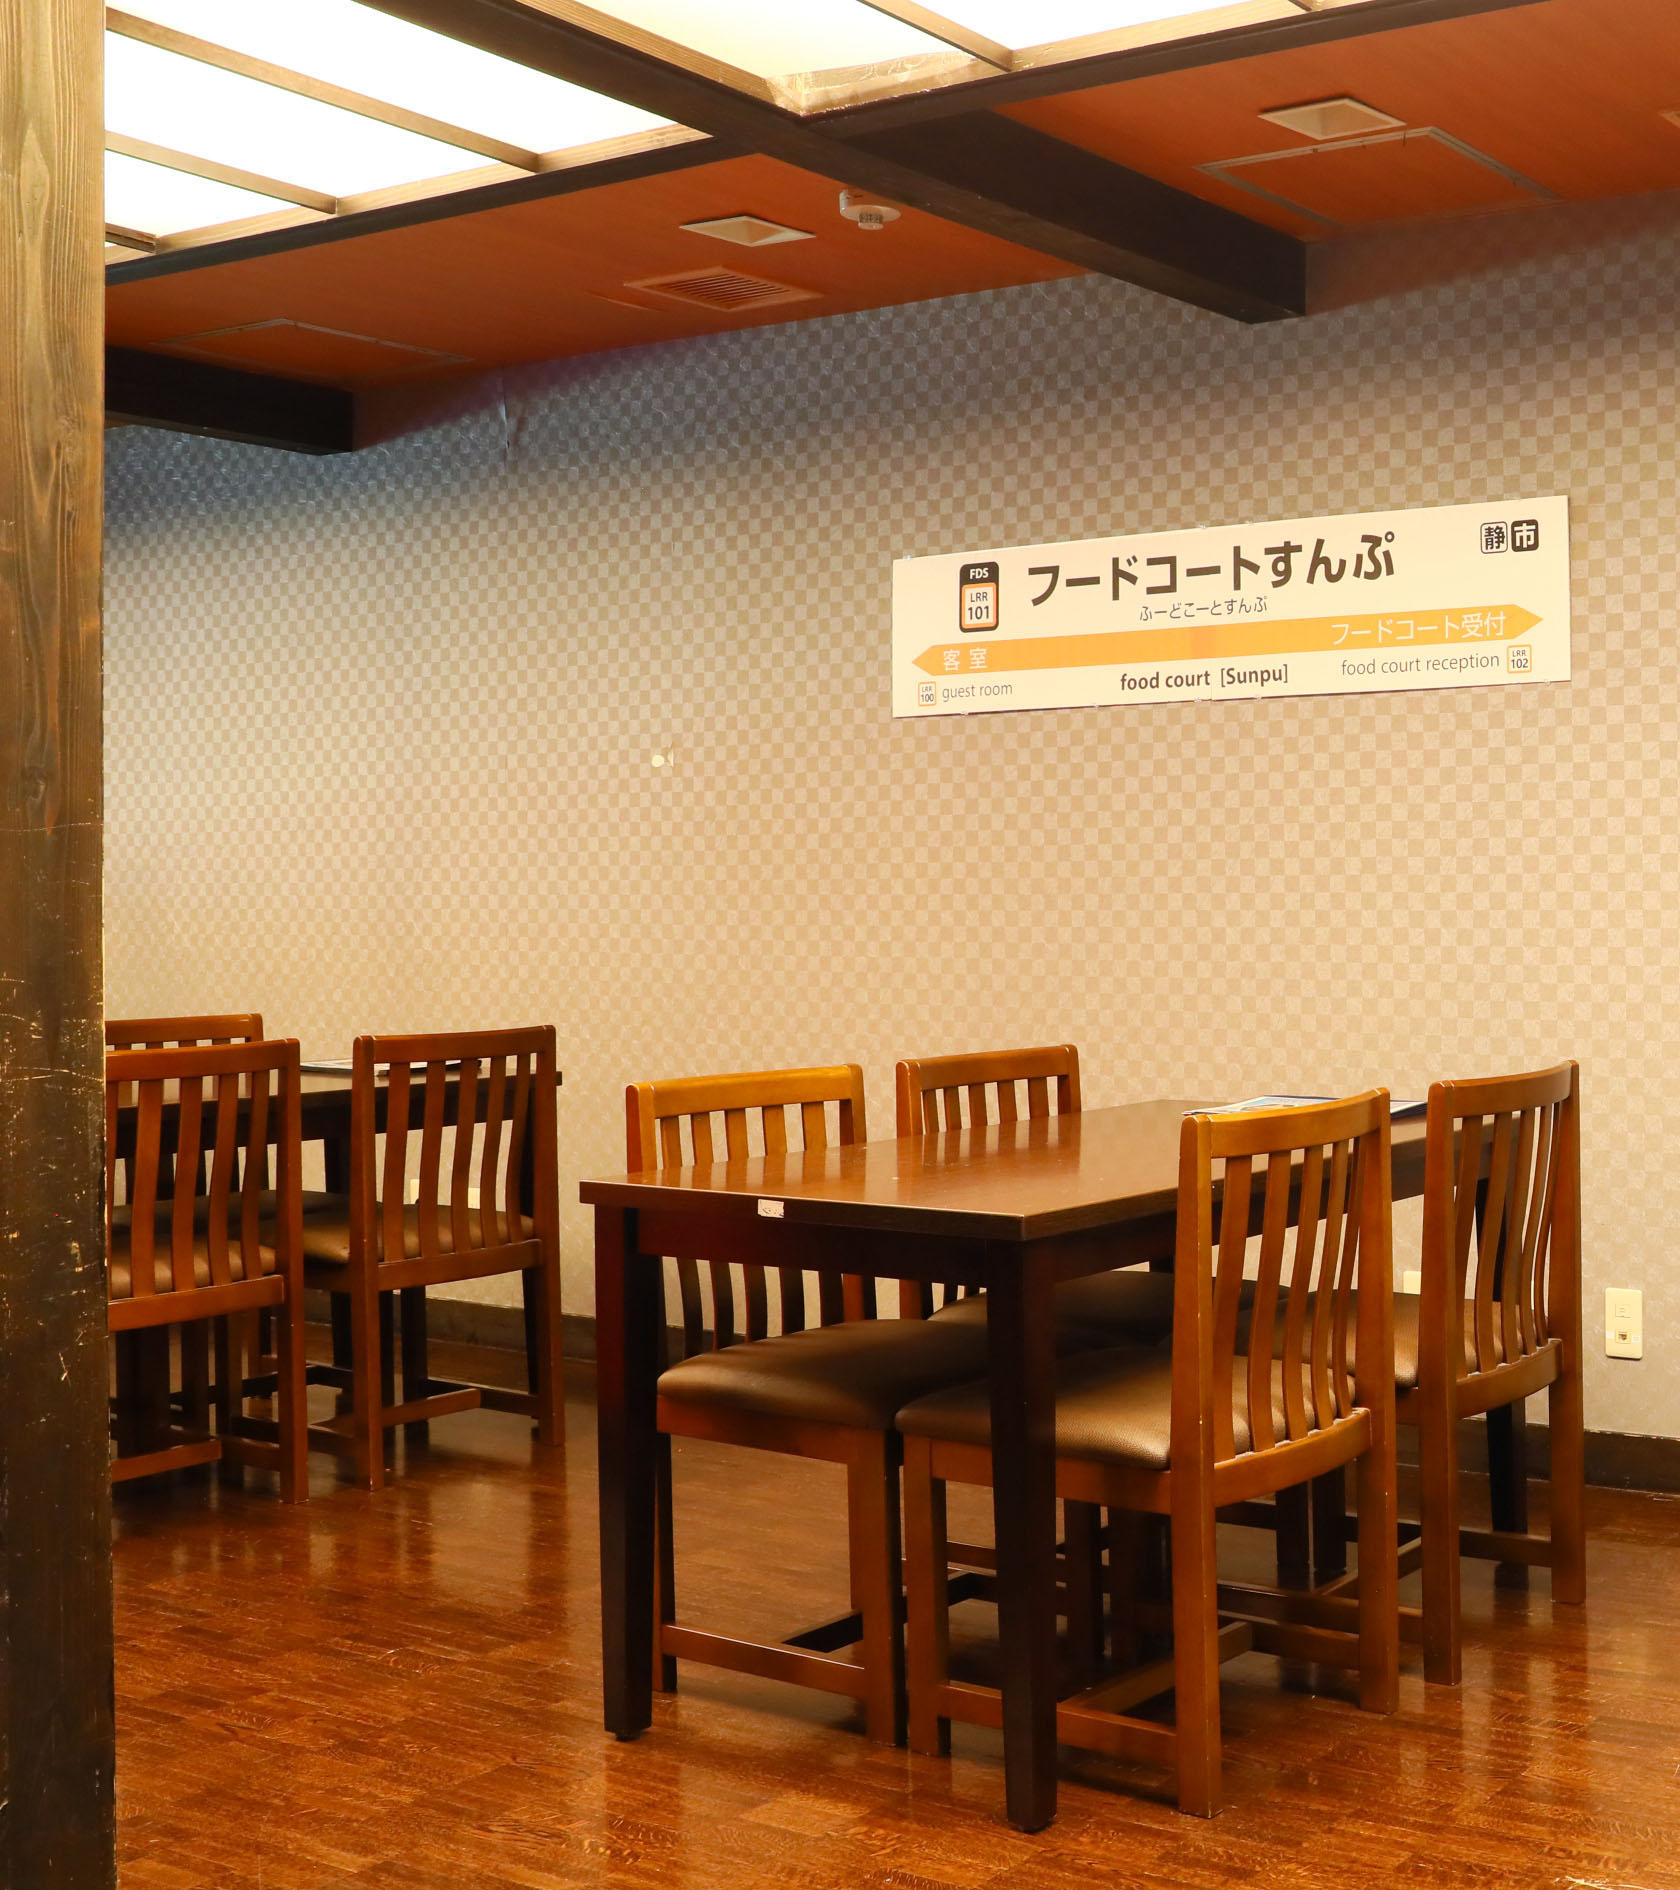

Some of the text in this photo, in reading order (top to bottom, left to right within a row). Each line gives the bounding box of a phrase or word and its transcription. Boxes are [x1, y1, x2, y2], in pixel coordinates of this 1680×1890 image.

[969, 567, 989, 580] FDS
[1028, 531, 1395, 607] フードコートすんぷ
[970, 591, 988, 602] LRR
[967, 605, 990, 621] 101
[1139, 596, 1268, 621] ふーどこーとすんぷ
[1331, 611, 1507, 645] フードコート受付
[943, 648, 988, 672] 客室
[1512, 649, 1527, 658] LRR
[1341, 653, 1500, 676] food court reception
[1510, 657, 1529, 670] 102
[1120, 671, 1160, 691] food
[1165, 670, 1210, 689] court
[920, 693, 934, 703] 100
[942, 684, 1013, 703] guest room
